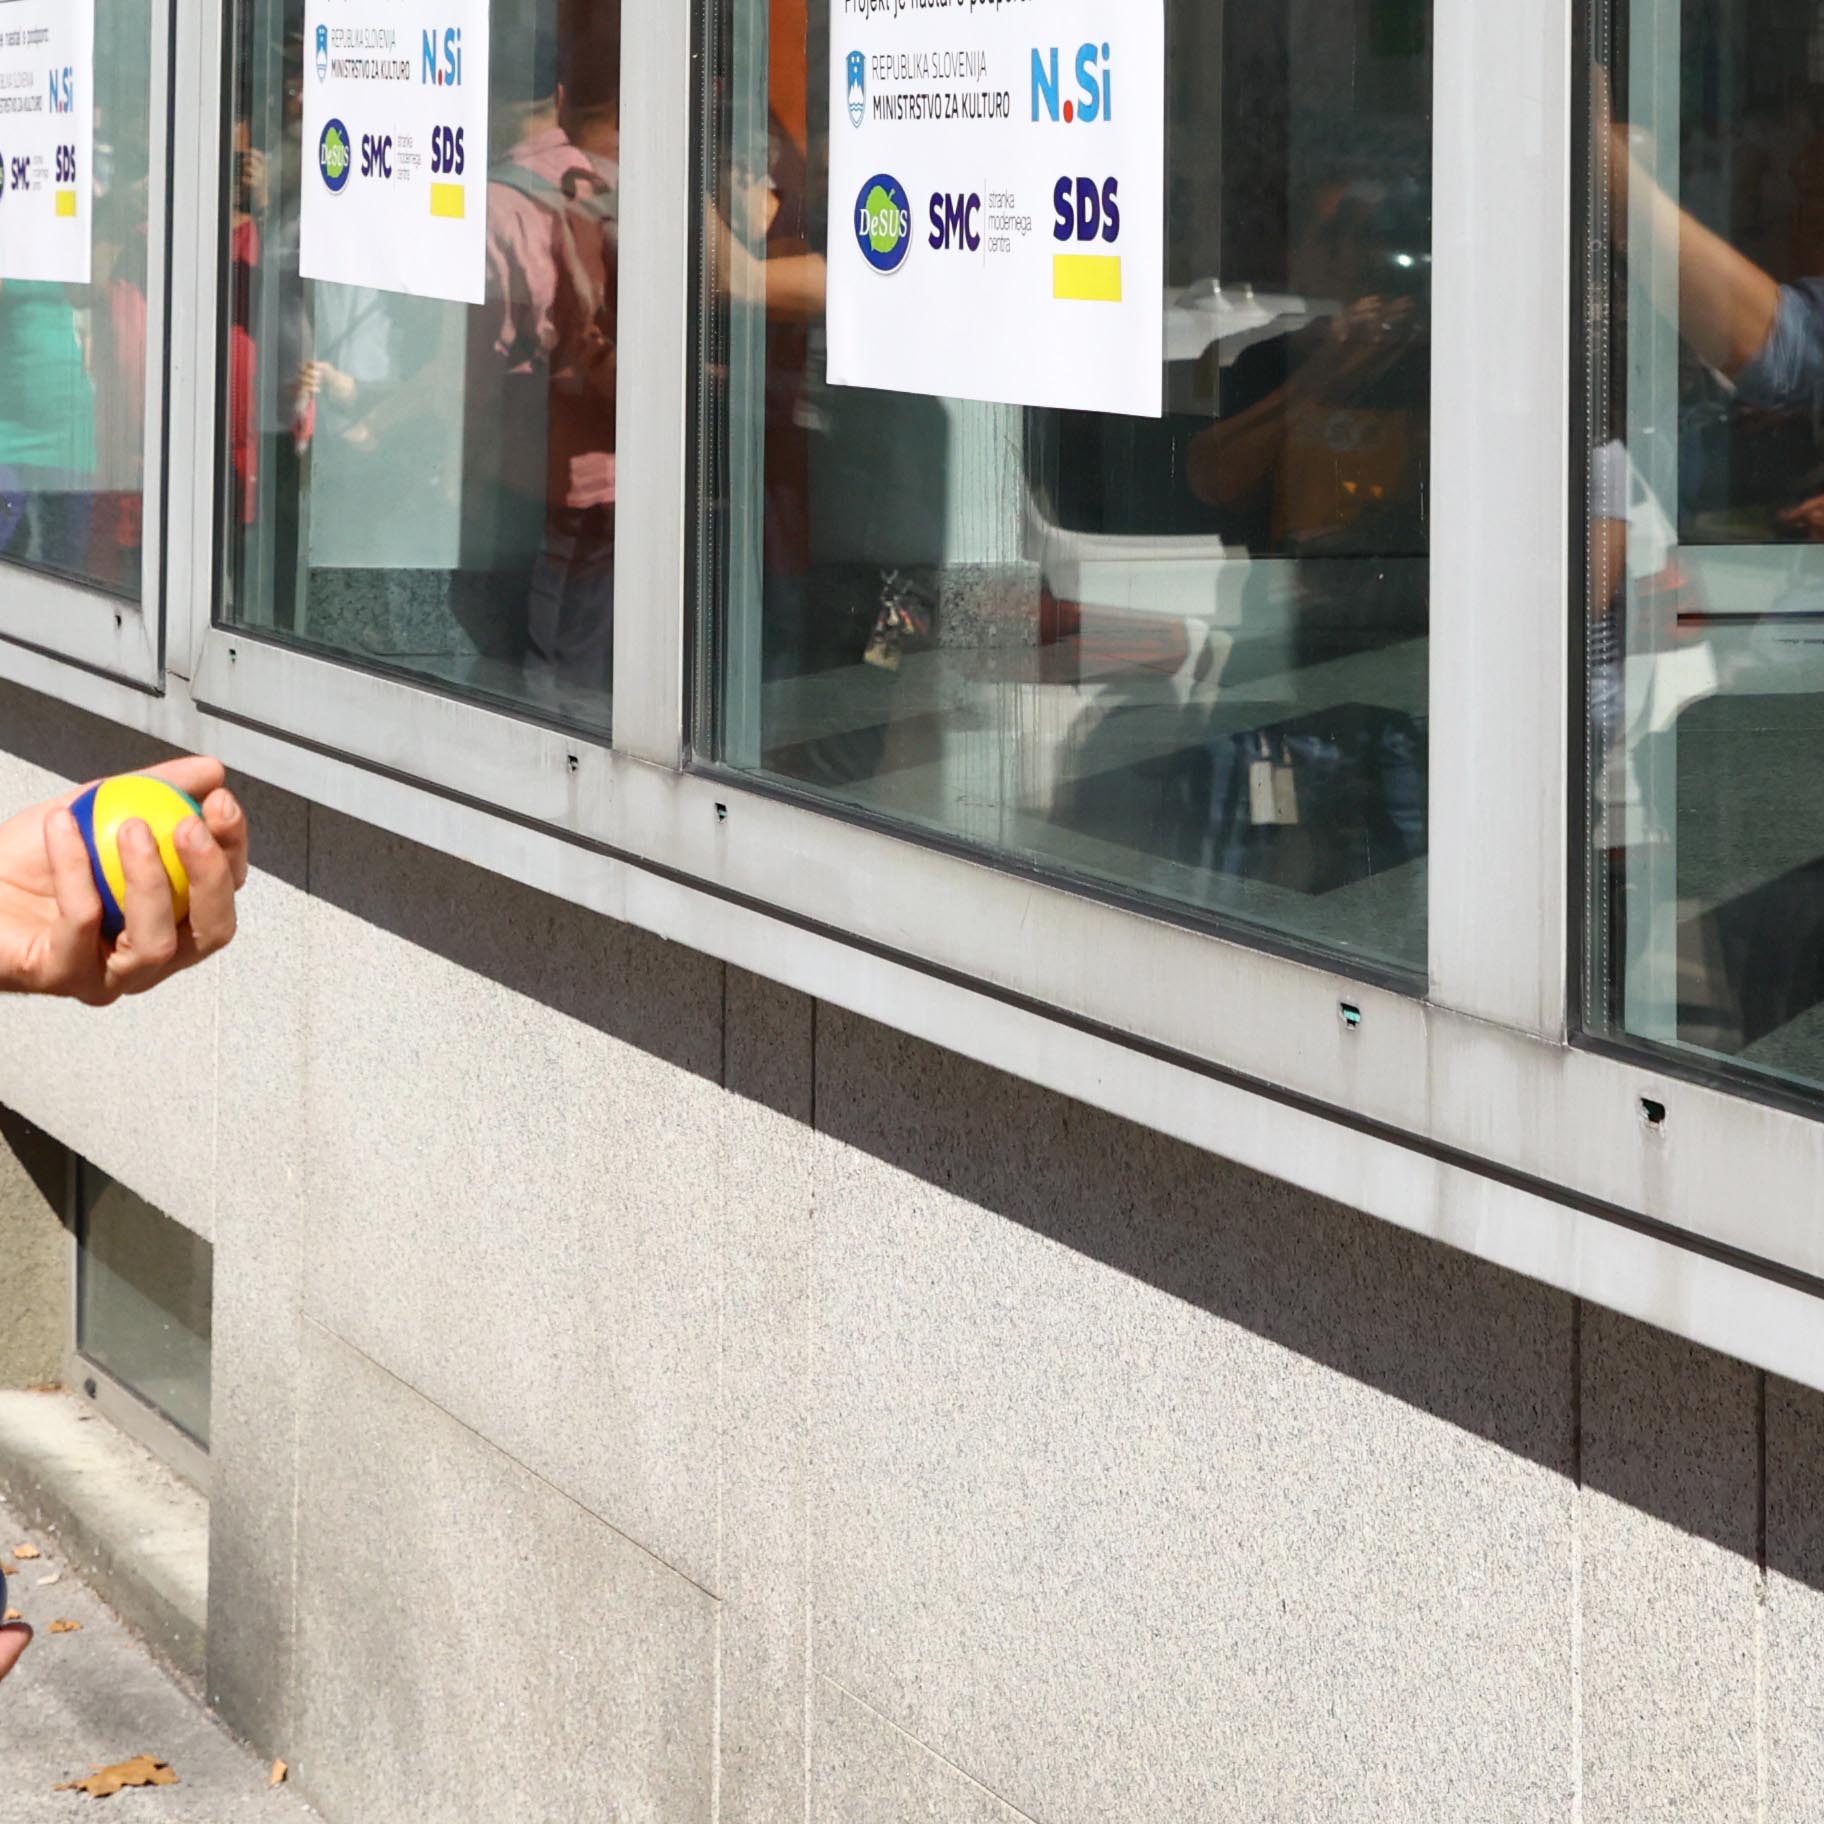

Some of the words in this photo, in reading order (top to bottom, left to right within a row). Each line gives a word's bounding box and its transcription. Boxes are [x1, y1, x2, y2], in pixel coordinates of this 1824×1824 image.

[871, 52, 930, 81] REPUBLIKA
[931, 50, 988, 84] SLOVENIJA
[872, 92, 942, 121] MINISTRSTVO
[944, 92, 960, 120] ZA
[961, 90, 1010, 120] KULTURO
[56, 145, 76, 182] SDS
[362, 134, 392, 178] SMC
[432, 125, 465, 175] SDS
[858, 207, 909, 239] DeSUS
[927, 191, 981, 252] SMC
[1053, 175, 1120, 244] SDS
